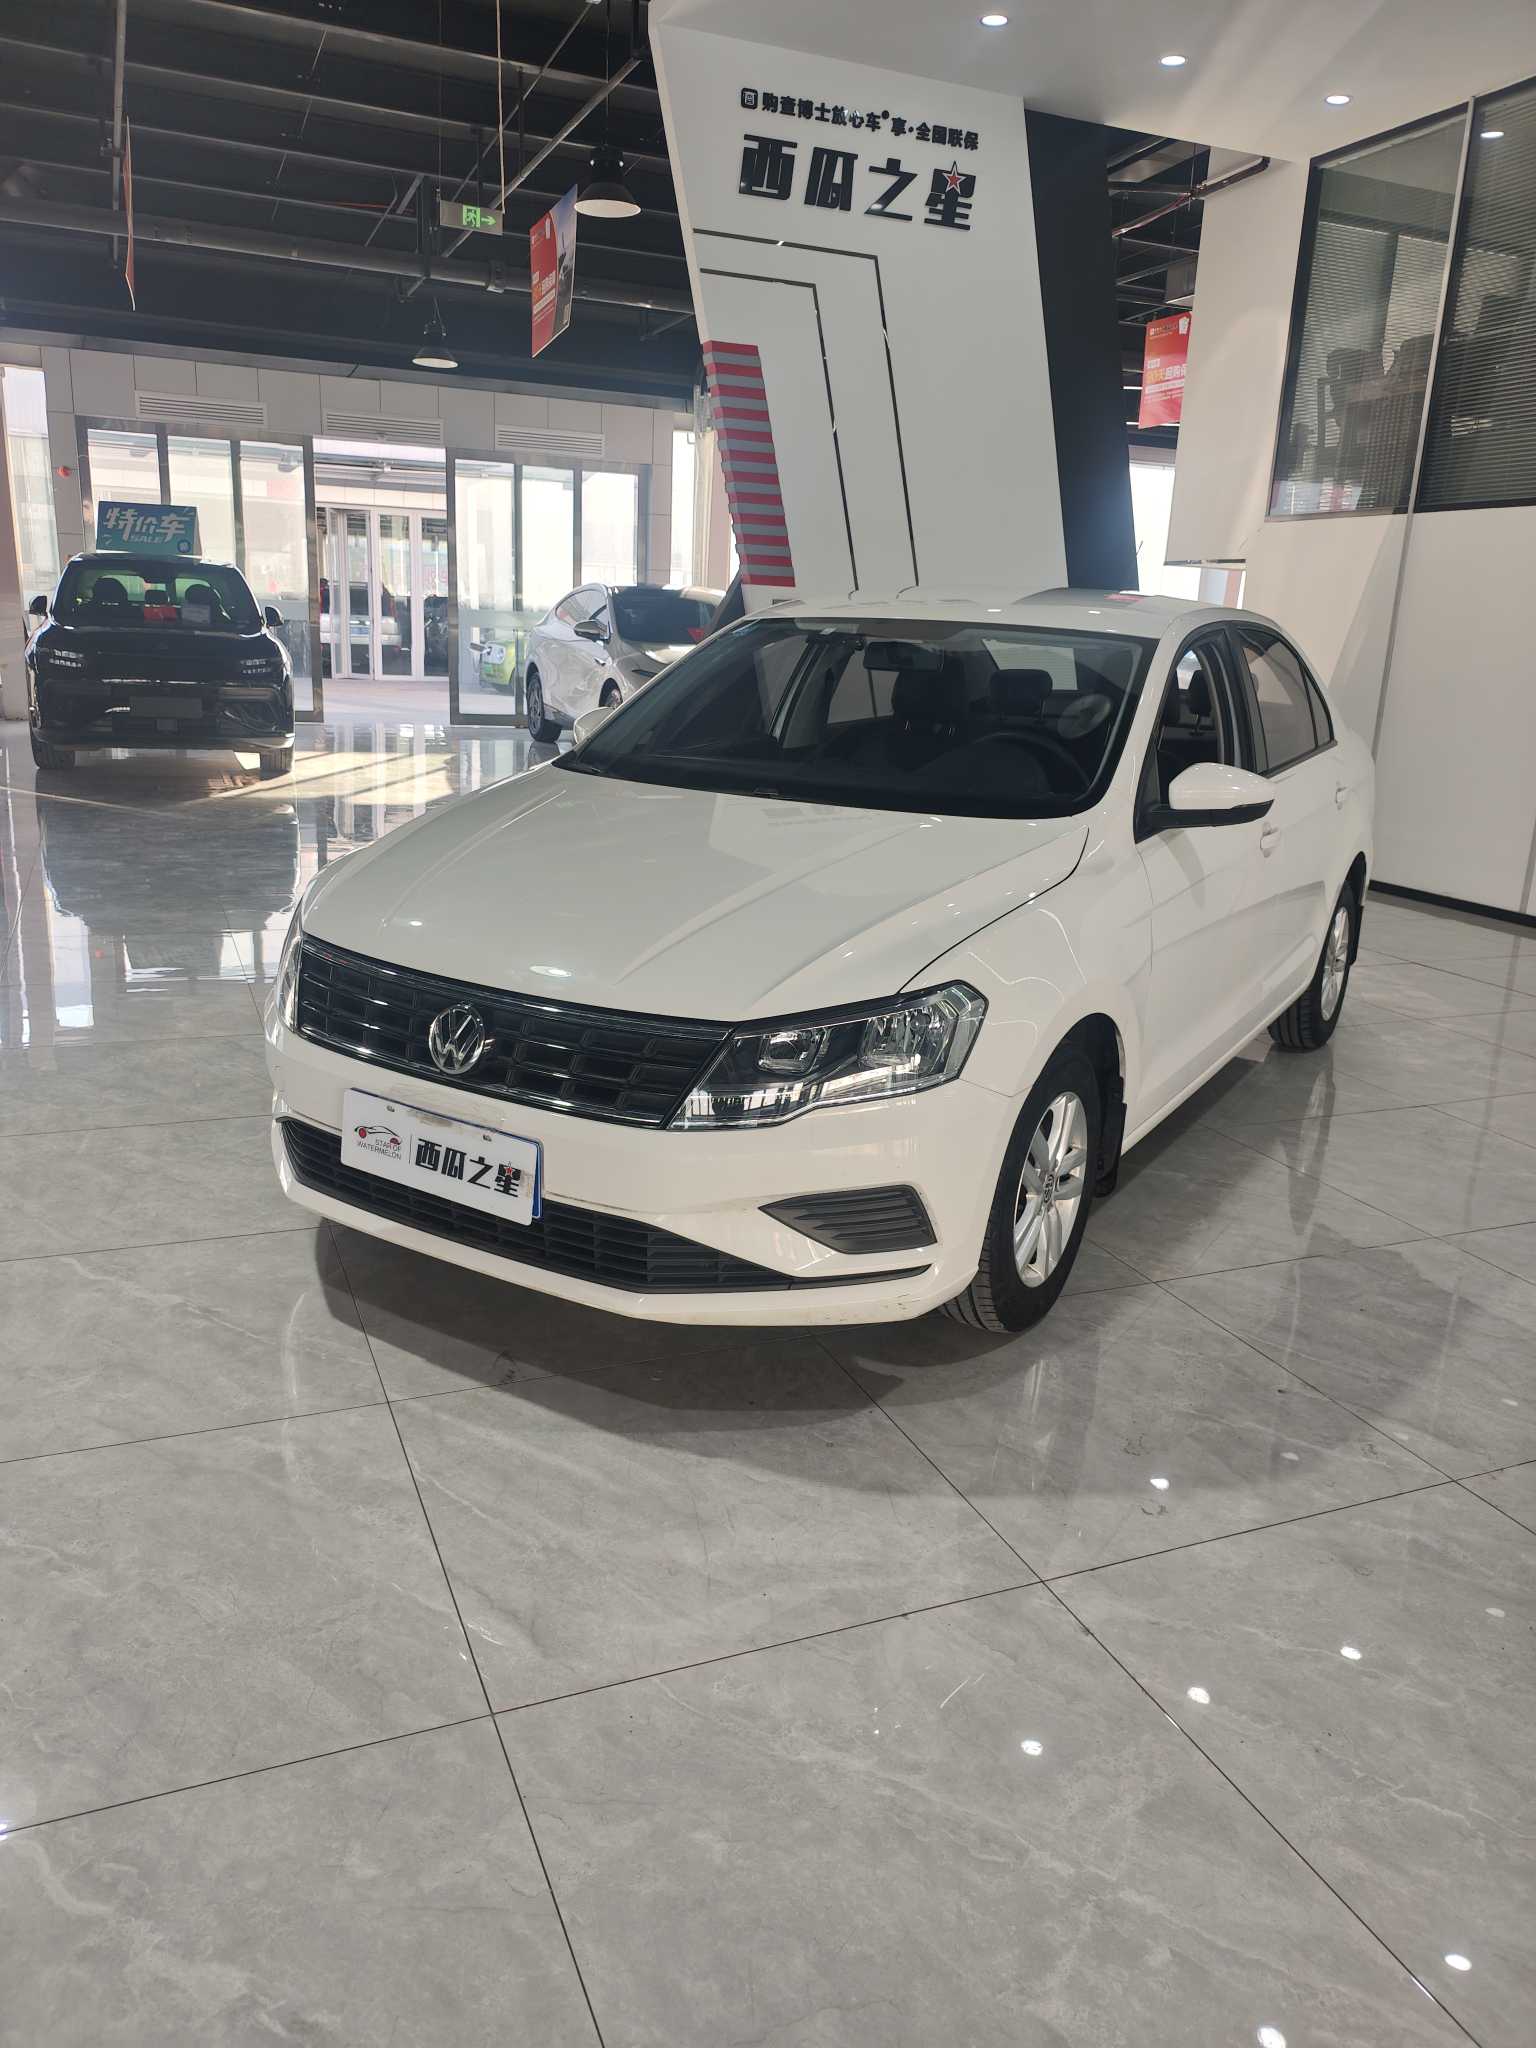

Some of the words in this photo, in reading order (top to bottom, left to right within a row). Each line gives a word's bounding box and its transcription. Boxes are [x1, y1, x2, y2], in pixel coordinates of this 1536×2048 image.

[738, 133, 977, 231] 西瓜之星
[104, 507, 188, 543] 特价车
[358, 1140, 402, 1161] WATERMELON
[415, 1138, 522, 1198] 西瓜之星
